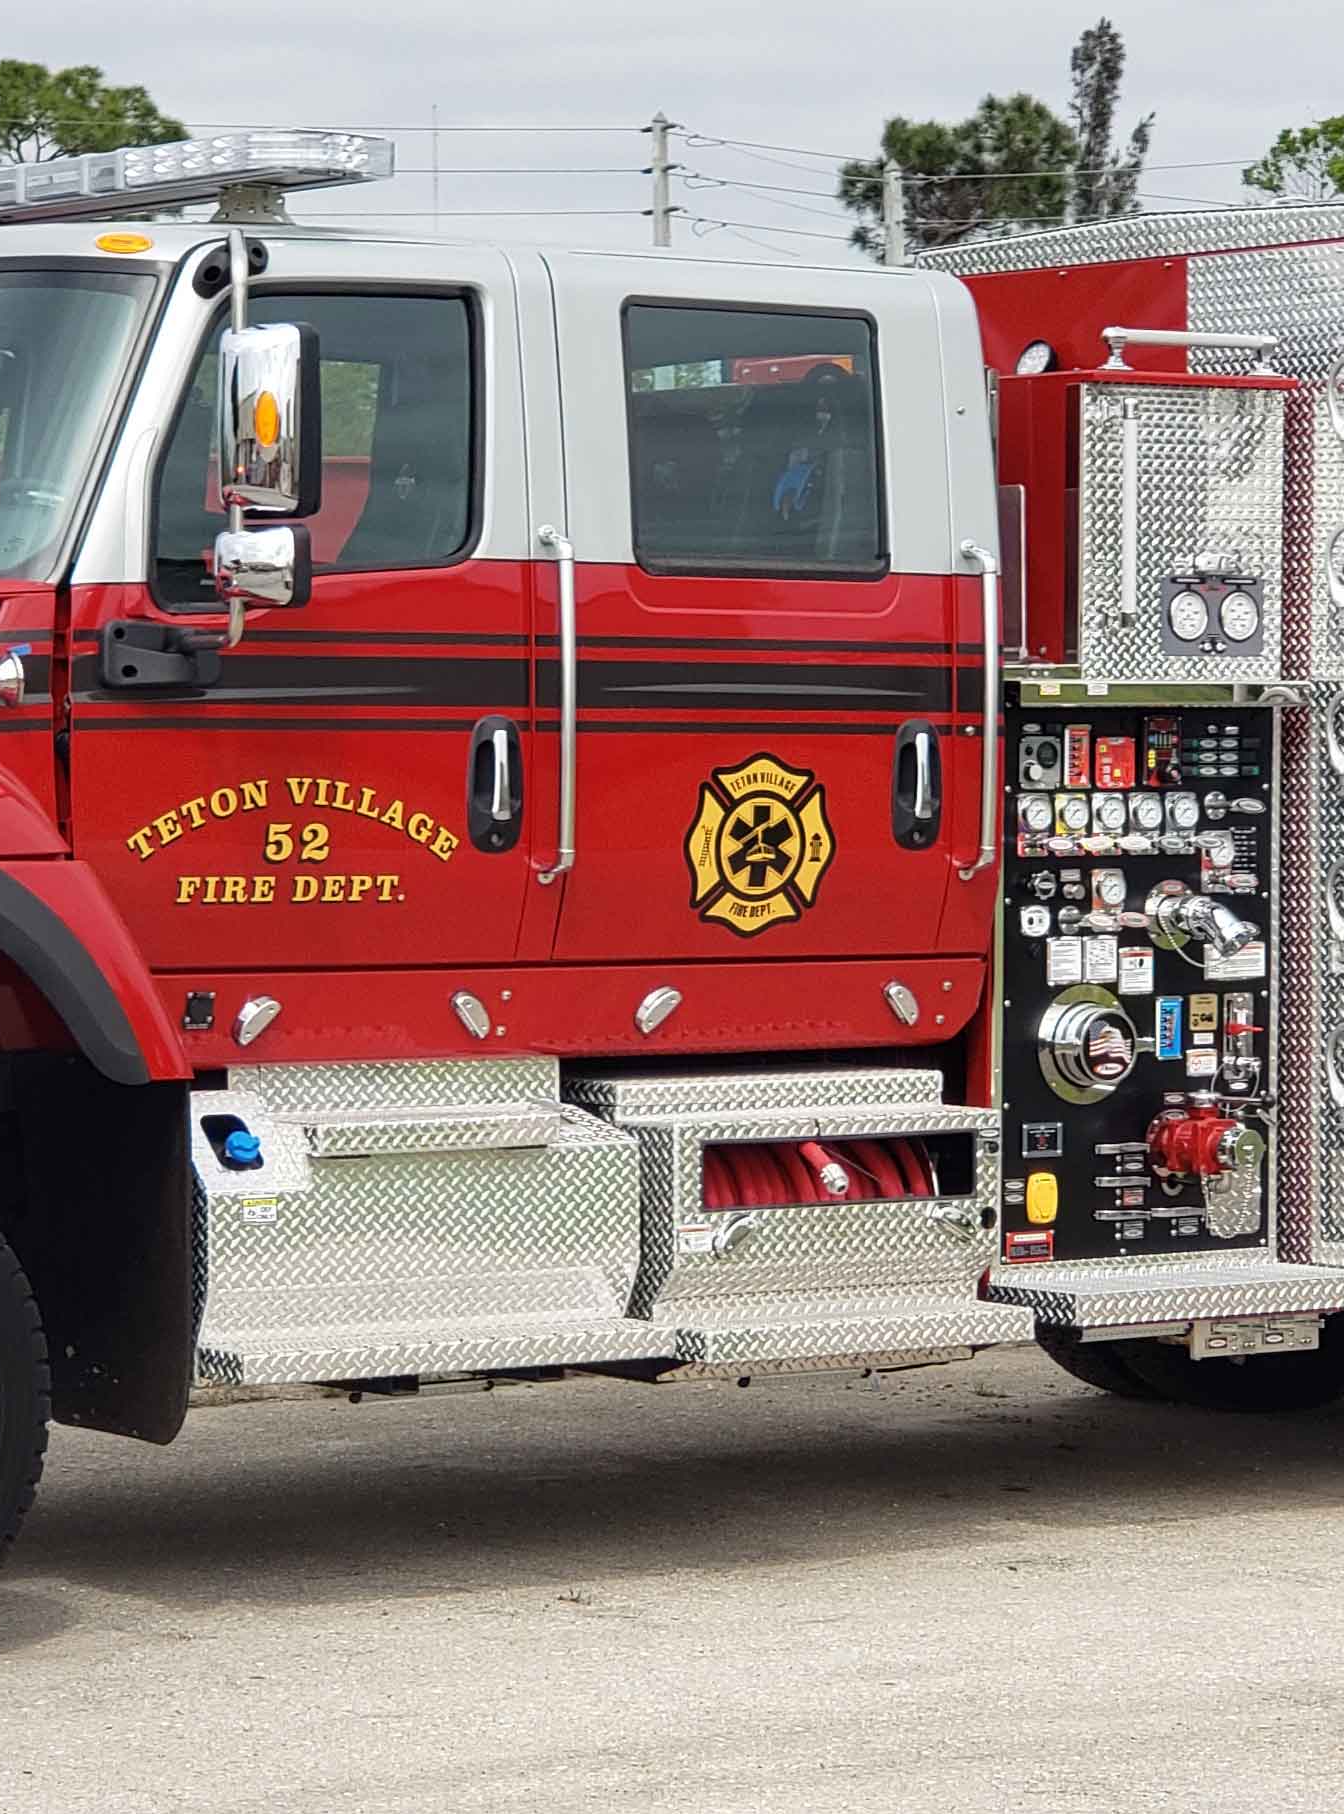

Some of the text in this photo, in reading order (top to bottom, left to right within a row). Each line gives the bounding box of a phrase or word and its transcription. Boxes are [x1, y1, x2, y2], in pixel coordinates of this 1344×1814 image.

[730, 772, 797, 793] TETON VILLAGE
[126, 777, 460, 861] TETON VILLAGE
[264, 823, 330, 862] 52
[176, 875, 405, 904] FIRE DEPT.
[729, 903, 776, 918] FIRE DEPT.
